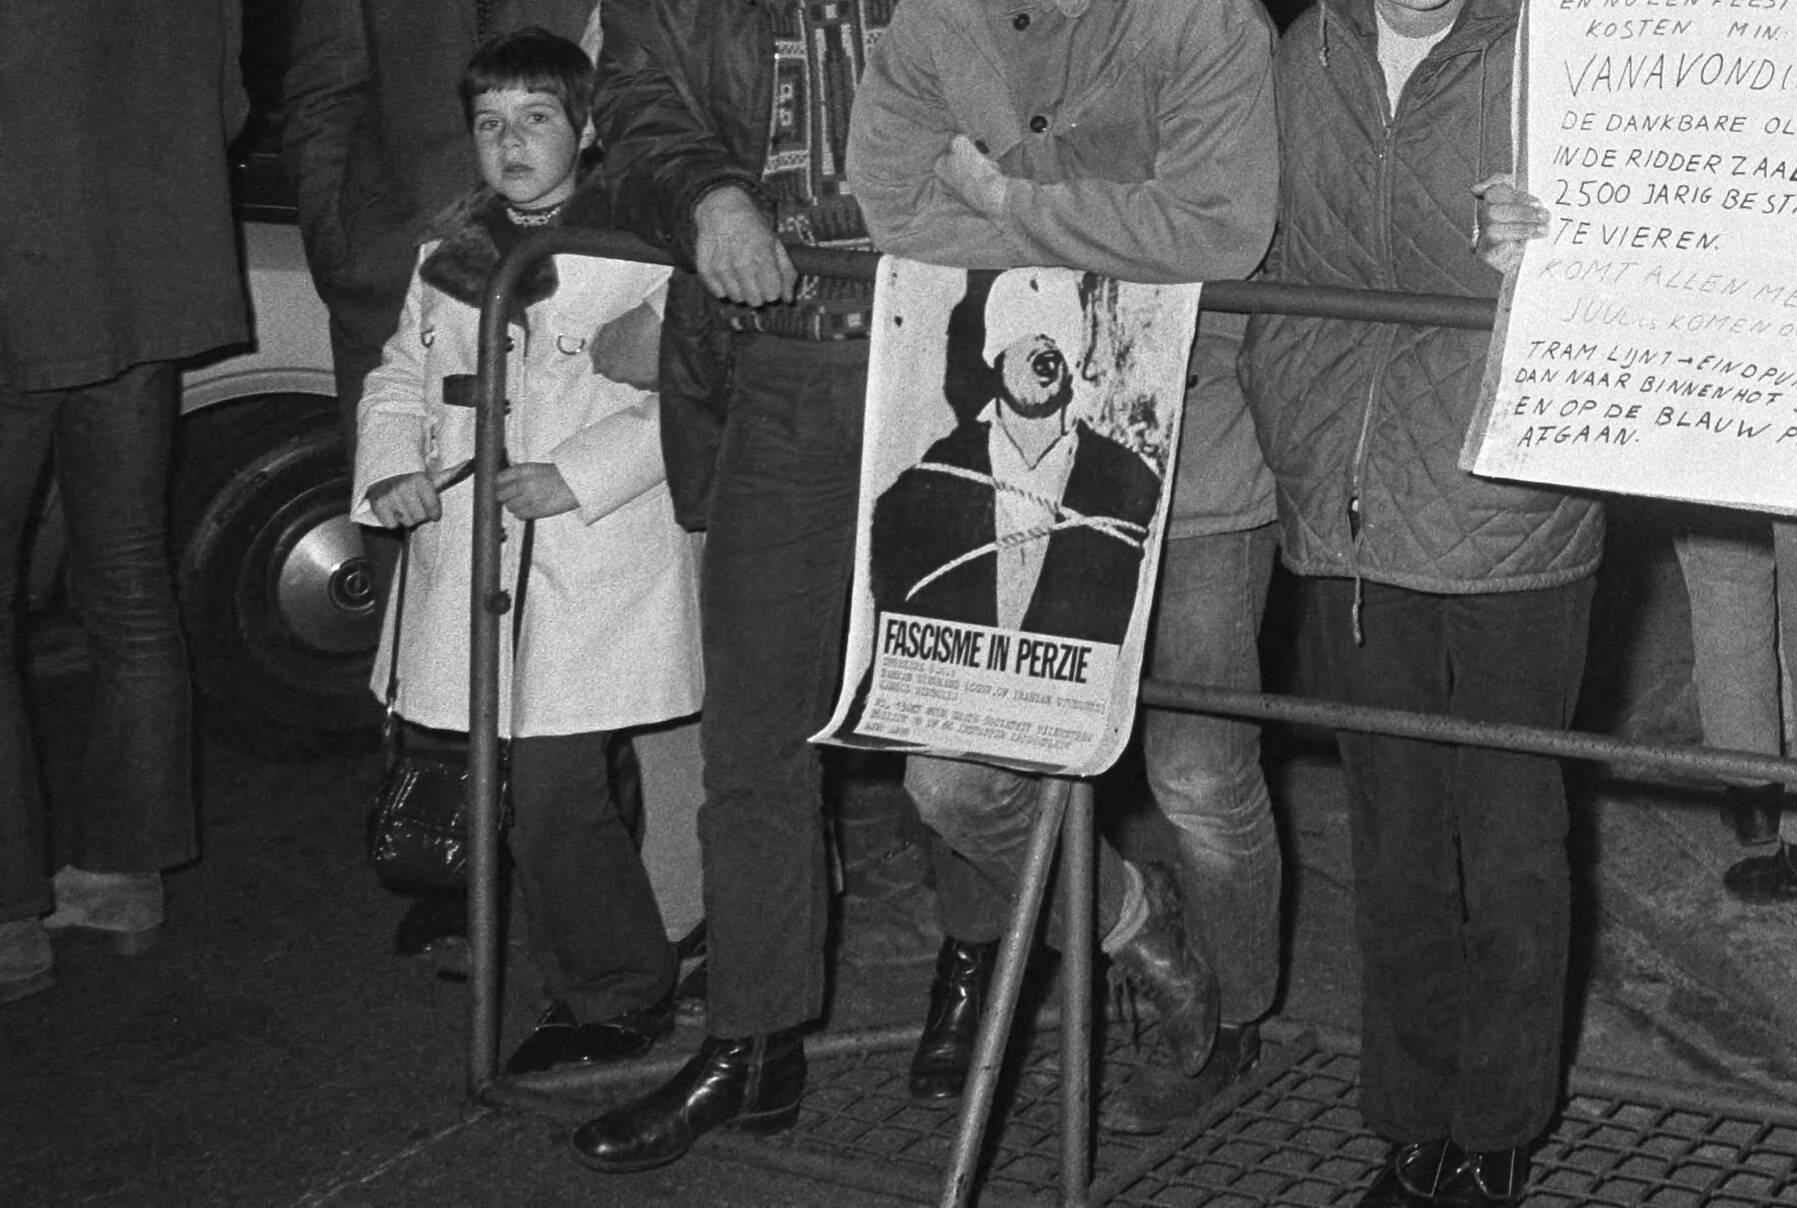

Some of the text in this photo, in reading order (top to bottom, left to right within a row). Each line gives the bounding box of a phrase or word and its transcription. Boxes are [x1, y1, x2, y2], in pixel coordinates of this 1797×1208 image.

[1585, 18, 1693, 40] KOSTEN
[1564, 52, 1775, 97] VANAVOND
[1560, 109, 1598, 131] DE
[1605, 112, 1748, 134] DANKBARE
[1552, 144, 1580, 167] IN
[1581, 146, 1618, 169] DE
[1554, 178, 1632, 208] 2500
[1641, 182, 1714, 206] JARIG
[1552, 216, 1721, 251] TE VIEREN.
[1538, 259, 1639, 283] KOMT
[1643, 264, 1750, 297] ALLEN
[1666, 313, 1773, 335] KOMEN
[1527, 339, 1598, 361] TRAM
[1606, 344, 1658, 370] LIJN
[1514, 367, 1560, 386] DAN
[1564, 368, 1633, 390] NAAR
[1513, 395, 1554, 417] EN
[1558, 398, 1598, 418] OP
[1602, 403, 1644, 420] DE
[1654, 405, 1772, 439] BLAUW
[884, 619, 985, 668] FASCISME
[986, 634, 1012, 672] IN
[1014, 637, 1093, 684] PERZIE
